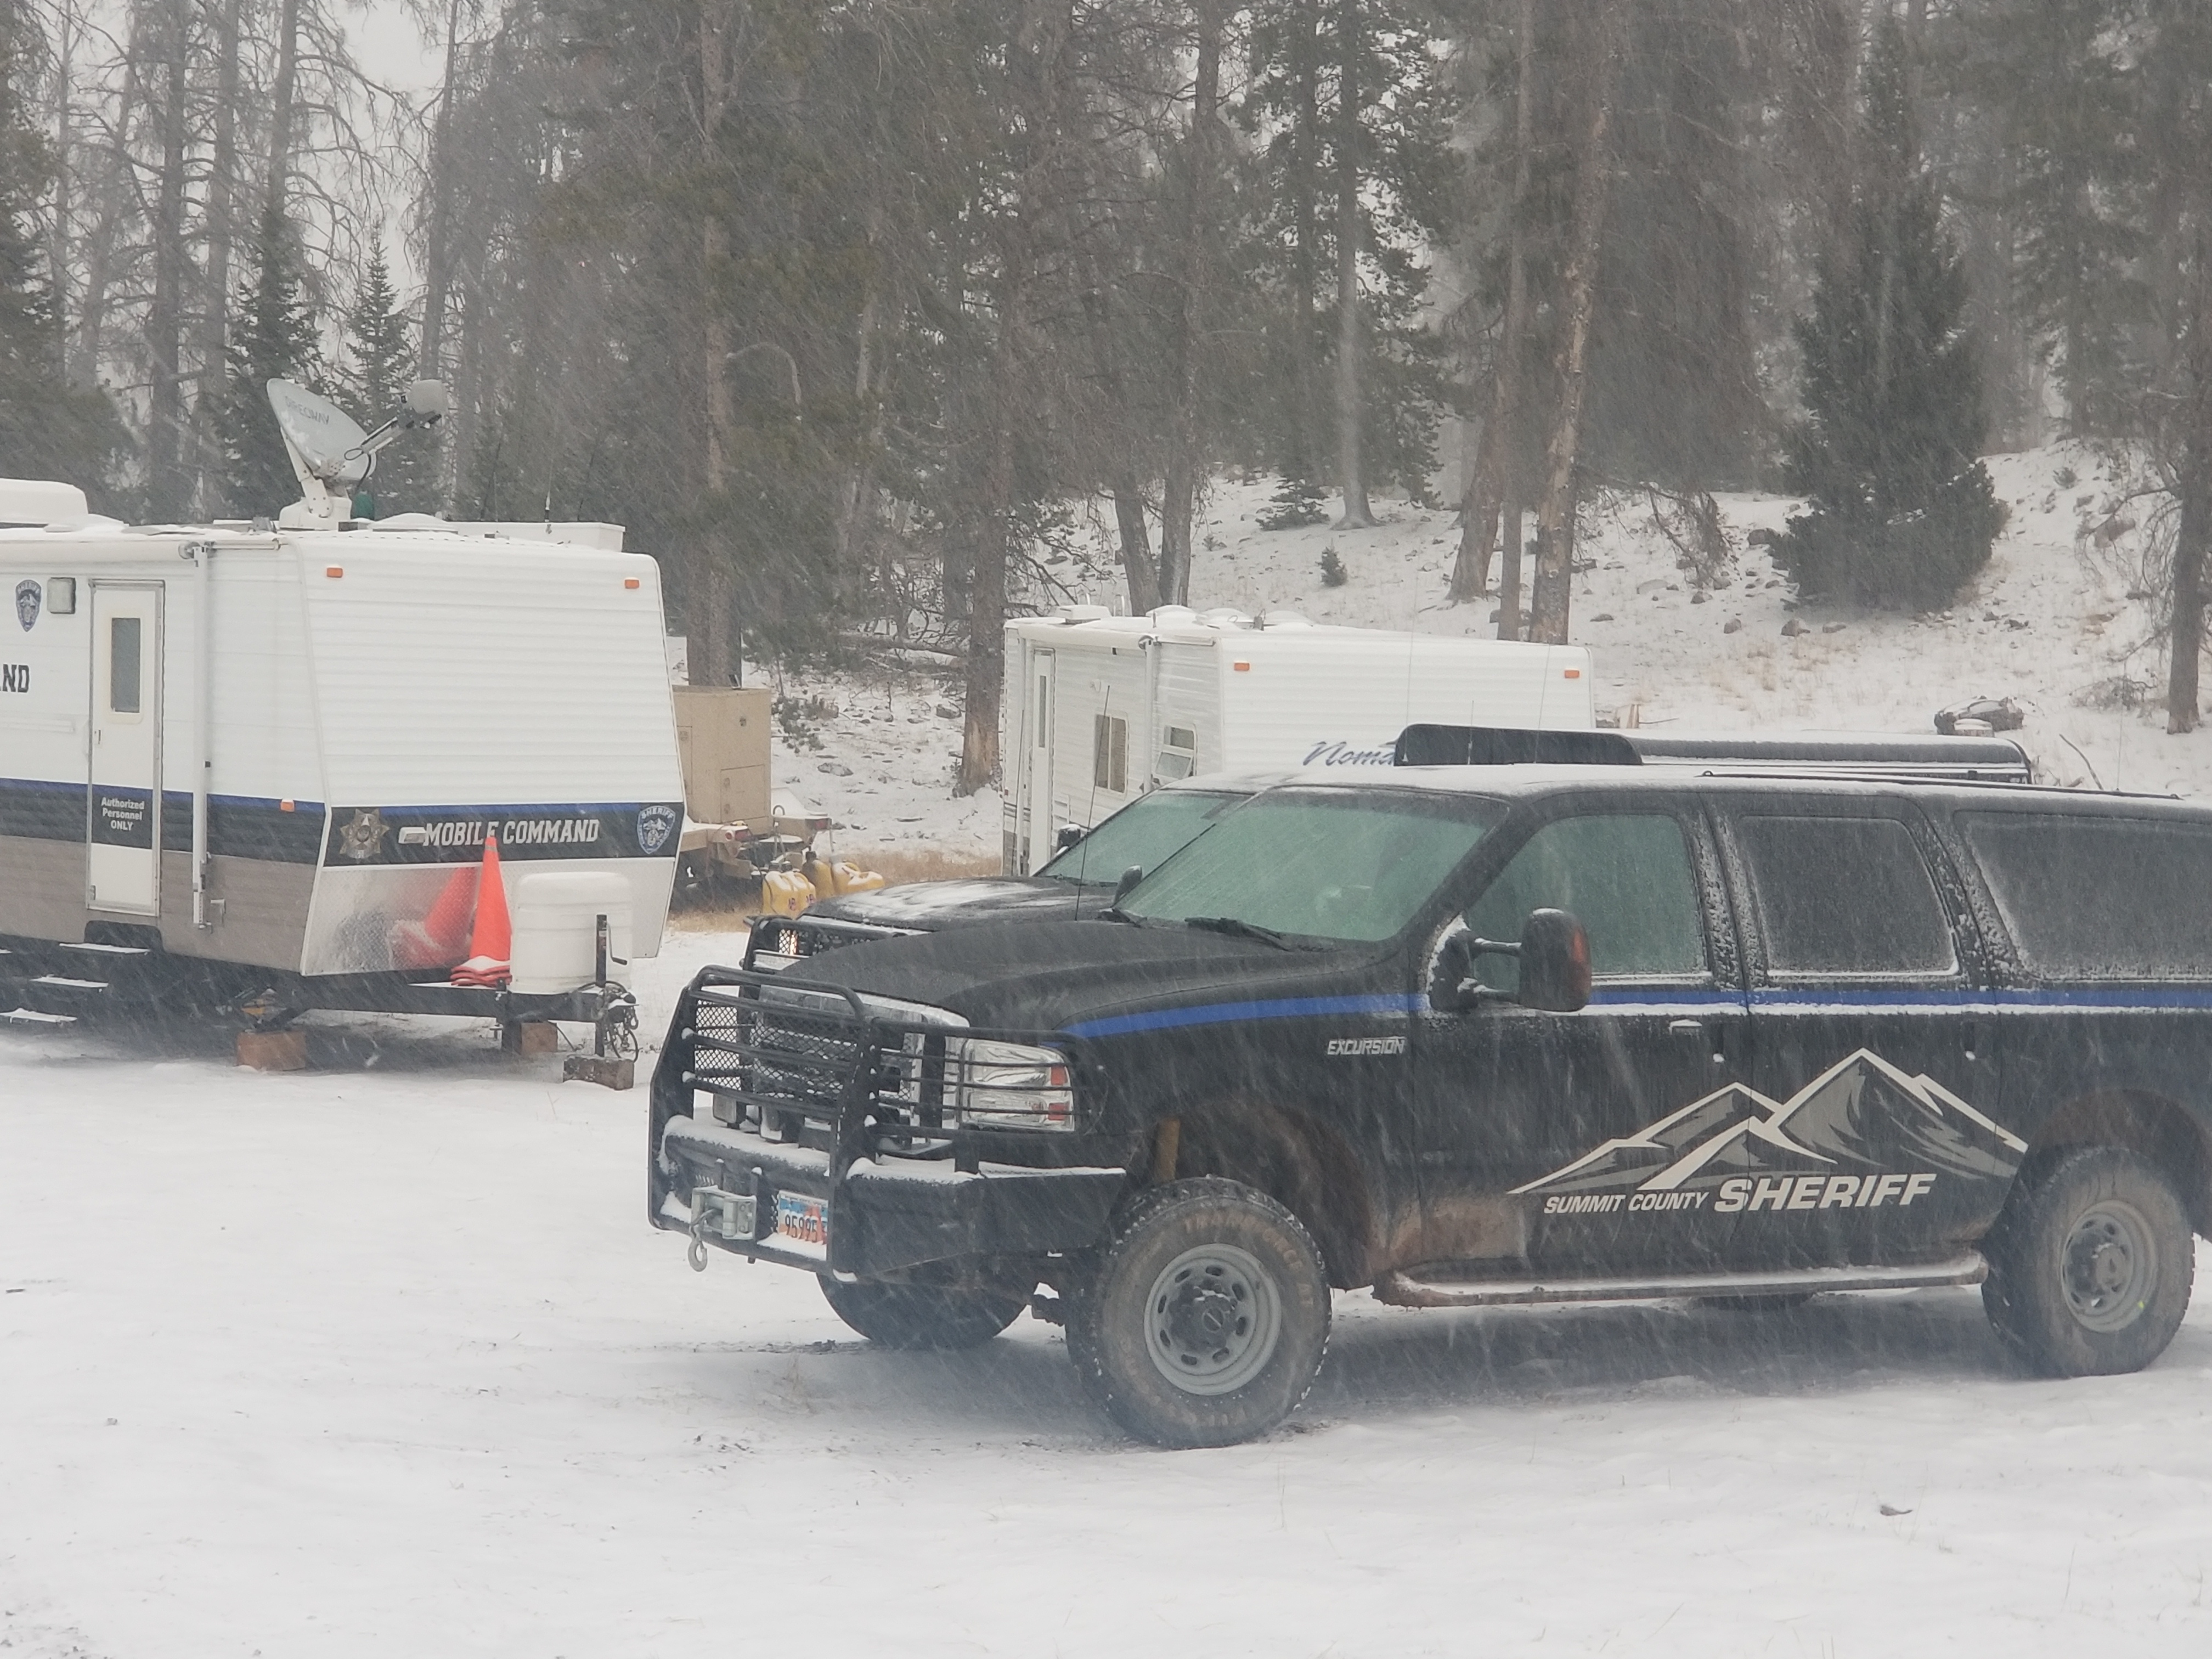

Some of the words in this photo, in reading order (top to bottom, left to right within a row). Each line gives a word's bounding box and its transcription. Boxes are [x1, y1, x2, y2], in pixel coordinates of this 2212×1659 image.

[0, 664, 30, 692] ND
[1303, 741, 1396, 766] Noma
[101, 797, 145, 810] Authorized
[102, 808, 143, 821] Personnel
[641, 807, 674, 819] SHERIFF
[110, 820, 133, 831] ONLY
[422, 821, 499, 846] MOBILE
[503, 819, 600, 844] COMMAND
[1327, 1039, 1406, 1055] EXCURSION
[1544, 1195, 1626, 1214] SUMMIT
[1628, 1192, 1709, 1211] COUNTY
[1714, 1173, 1937, 1212] SHERIFF
